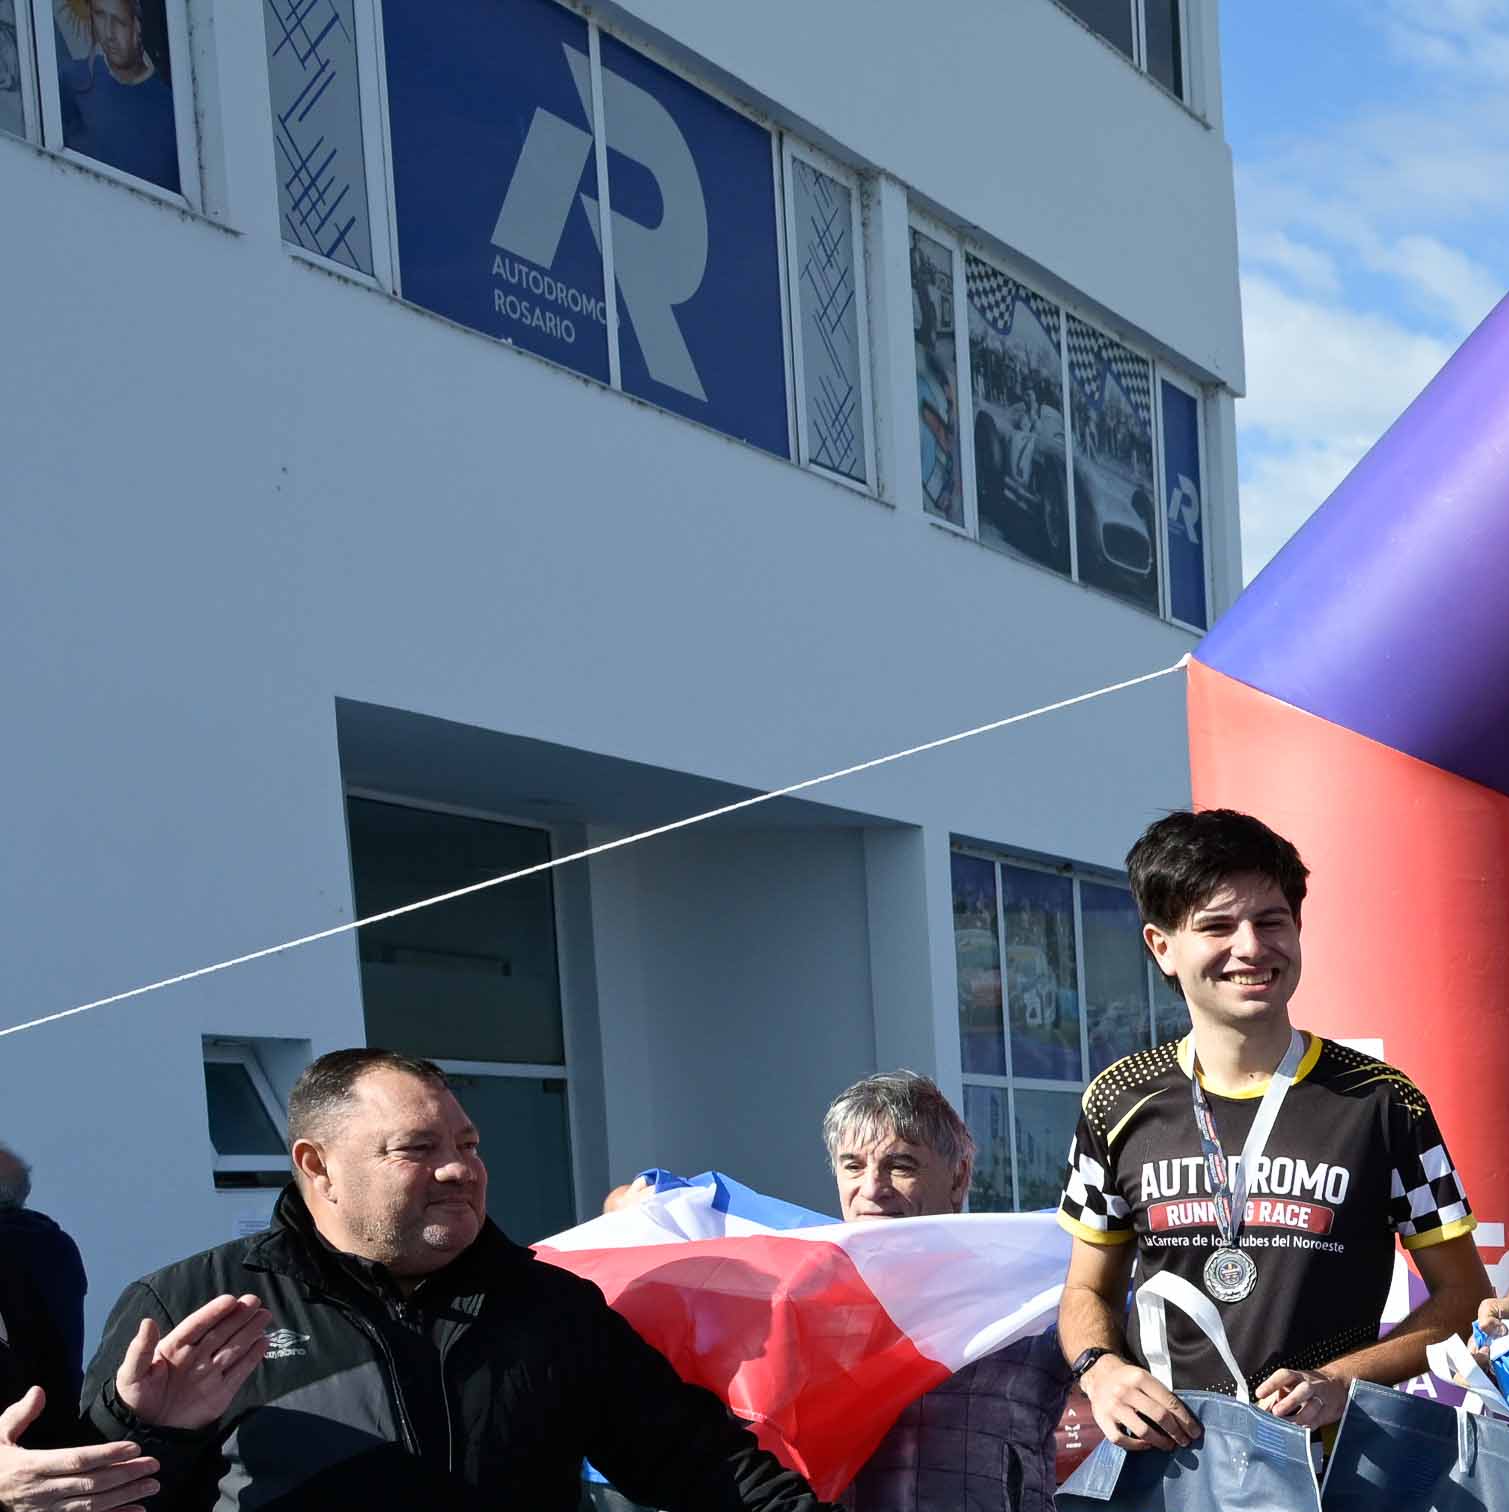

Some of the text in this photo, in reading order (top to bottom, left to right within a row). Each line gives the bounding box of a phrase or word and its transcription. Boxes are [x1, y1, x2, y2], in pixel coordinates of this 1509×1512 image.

[494, 287, 577, 344] ROSARIO
[1166, 1201, 1313, 1229] RUNNG RACE
[1192, 1235, 1208, 1247] de
[1239, 1235, 1270, 1248] lubes
[1271, 1235, 1291, 1249] del
[1292, 1236, 1345, 1254] Noroeste
